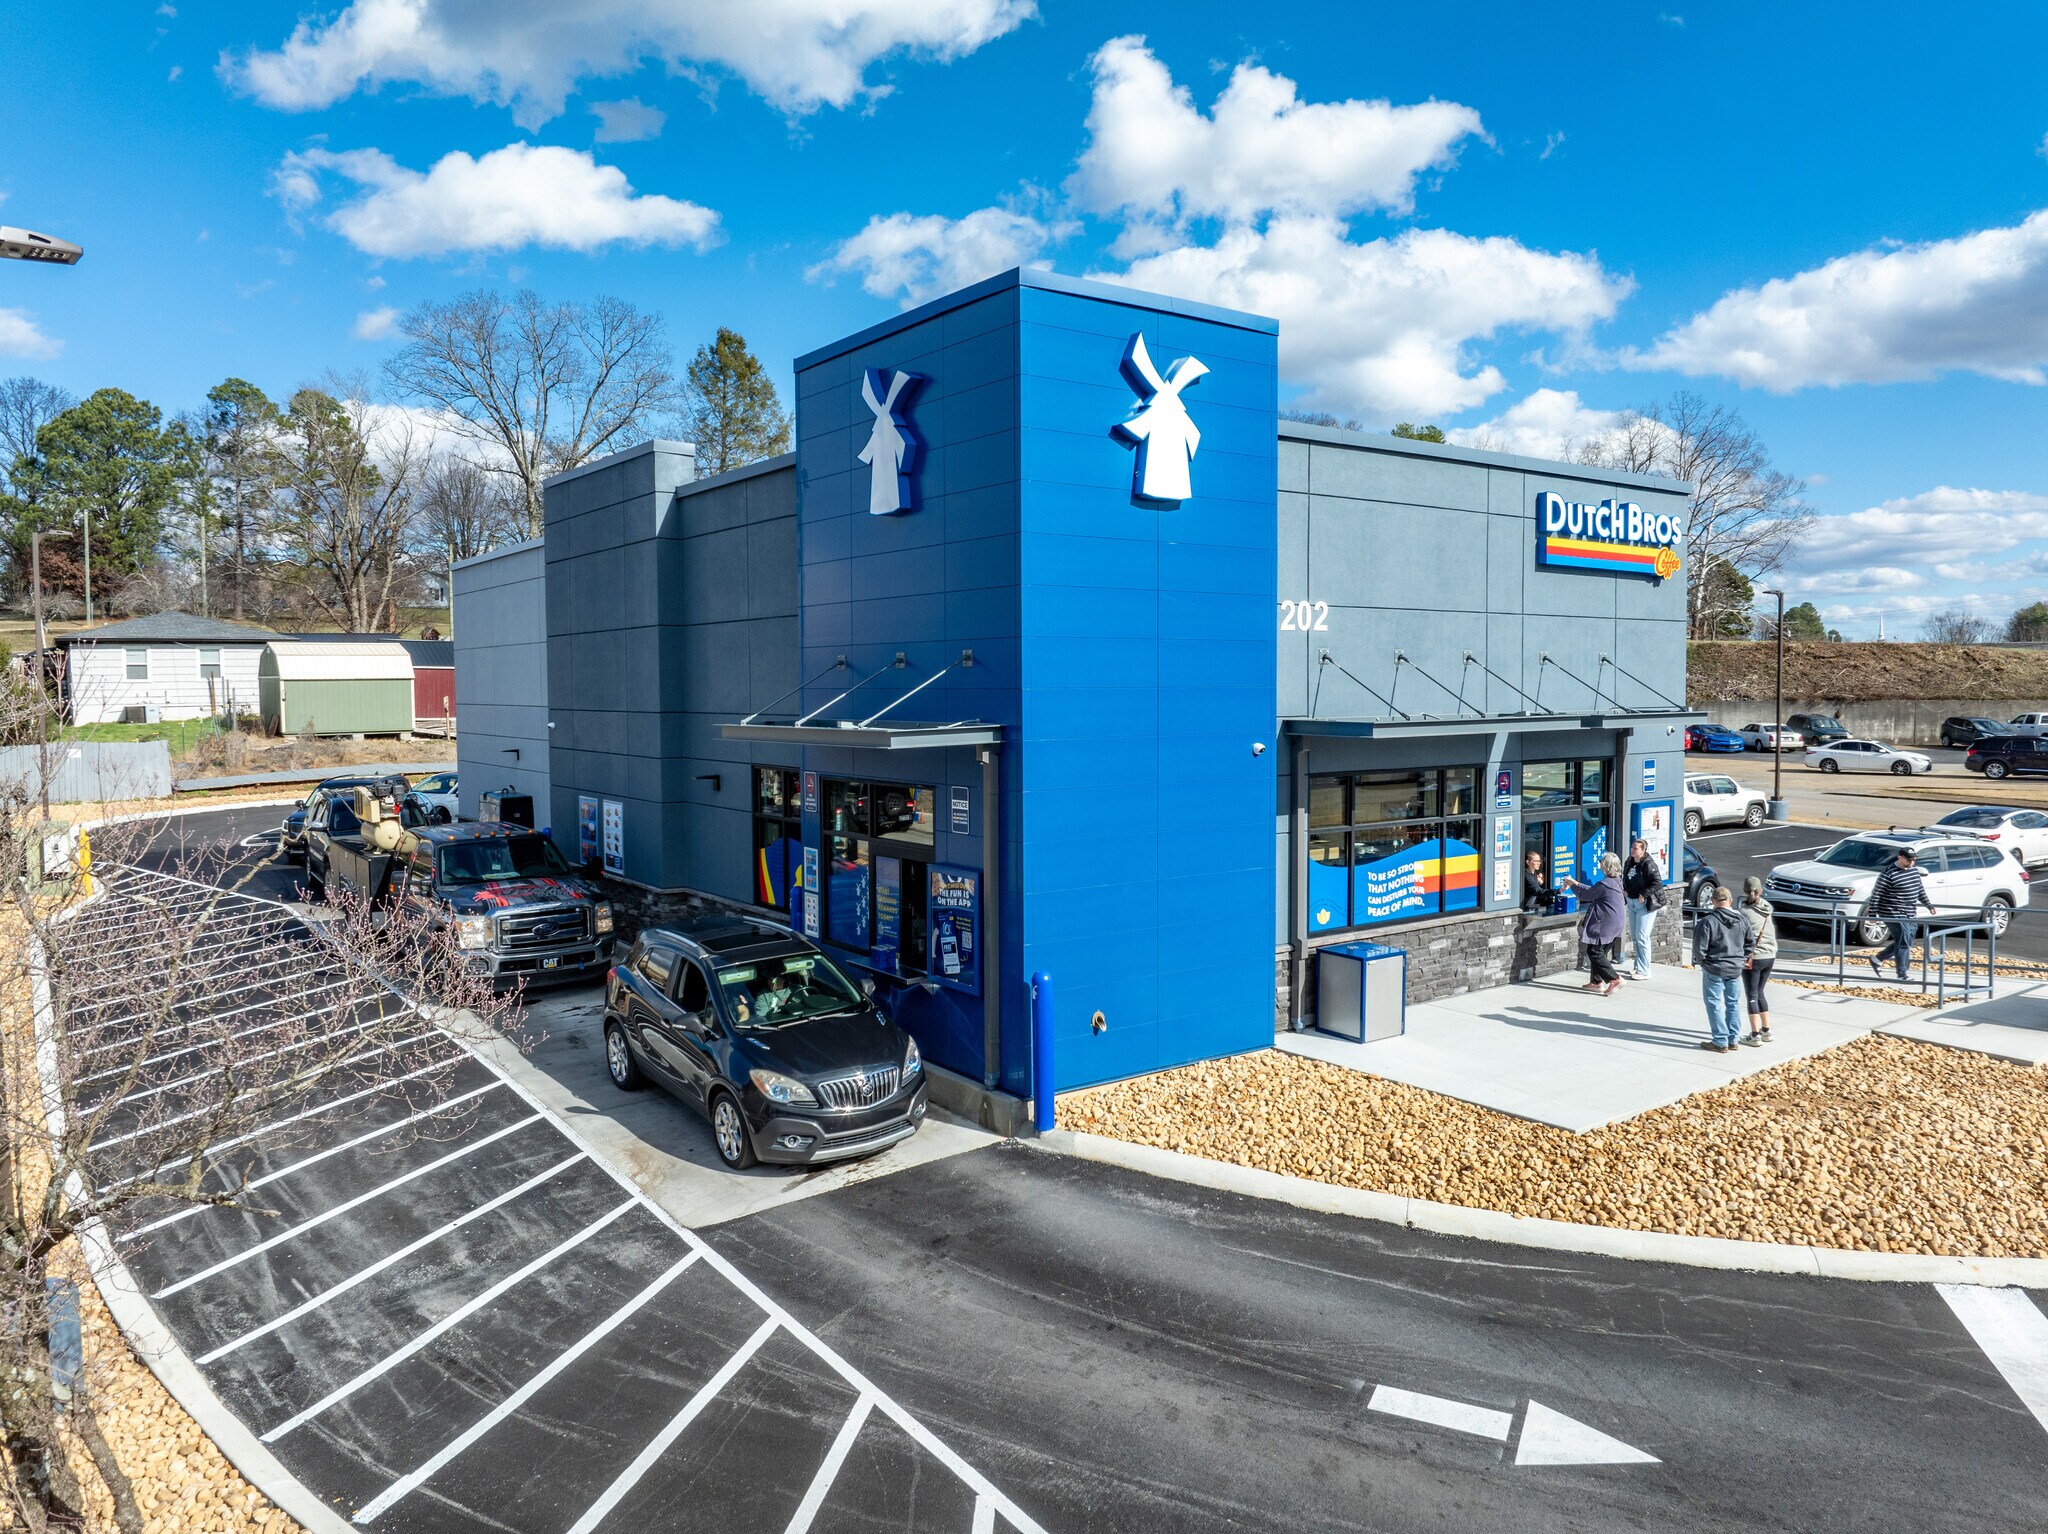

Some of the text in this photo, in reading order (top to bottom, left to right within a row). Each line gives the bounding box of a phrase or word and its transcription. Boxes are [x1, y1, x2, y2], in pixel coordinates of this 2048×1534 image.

[1546, 491, 1682, 545] DUTCH BROS
[1655, 547, 1680, 580] Coffee
[1280, 599, 1329, 632] 202
[953, 801, 968, 809] NOTICE
[1367, 871, 1378, 881] TO
[1378, 872, 1387, 881] BE
[1387, 869, 1397, 879] SO
[1367, 874, 1425, 894] THAT NOTHING
[937, 896, 972, 908] ON THE APP
[939, 888, 970, 899] THE FUN IS
[1367, 885, 1426, 905] CAN DISTURB YOUR
[1367, 905, 1391, 917] PEACE
[1390, 901, 1402, 912] OF
[1402, 896, 1426, 908] MIND.
[543, 957, 559, 969] CAT
